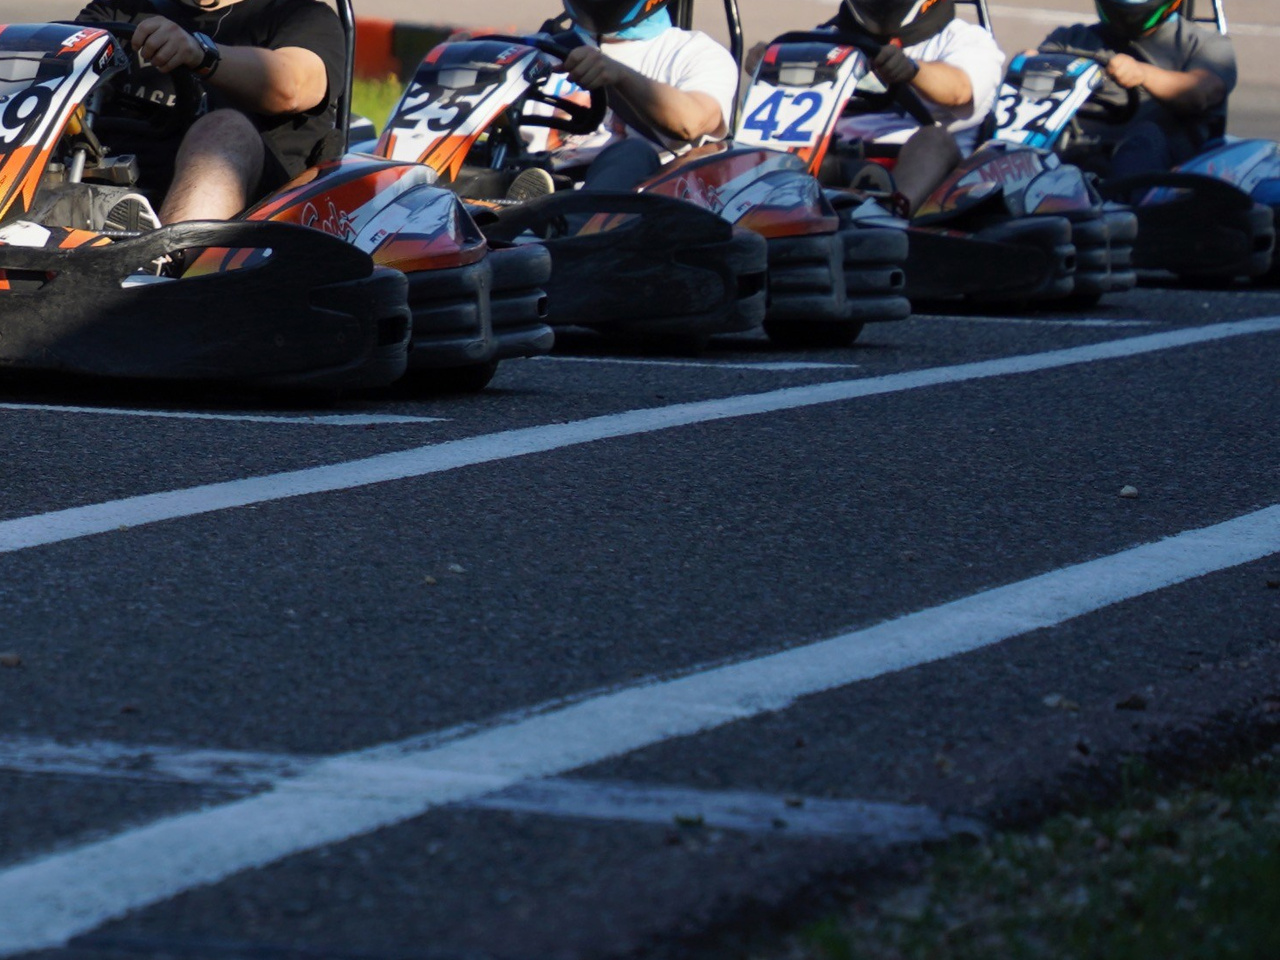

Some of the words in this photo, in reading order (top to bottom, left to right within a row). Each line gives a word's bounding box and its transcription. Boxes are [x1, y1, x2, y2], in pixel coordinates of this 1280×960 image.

[391, 83, 487, 132] 25
[743, 91, 823, 141] 42
[997, 95, 1061, 132] 32
